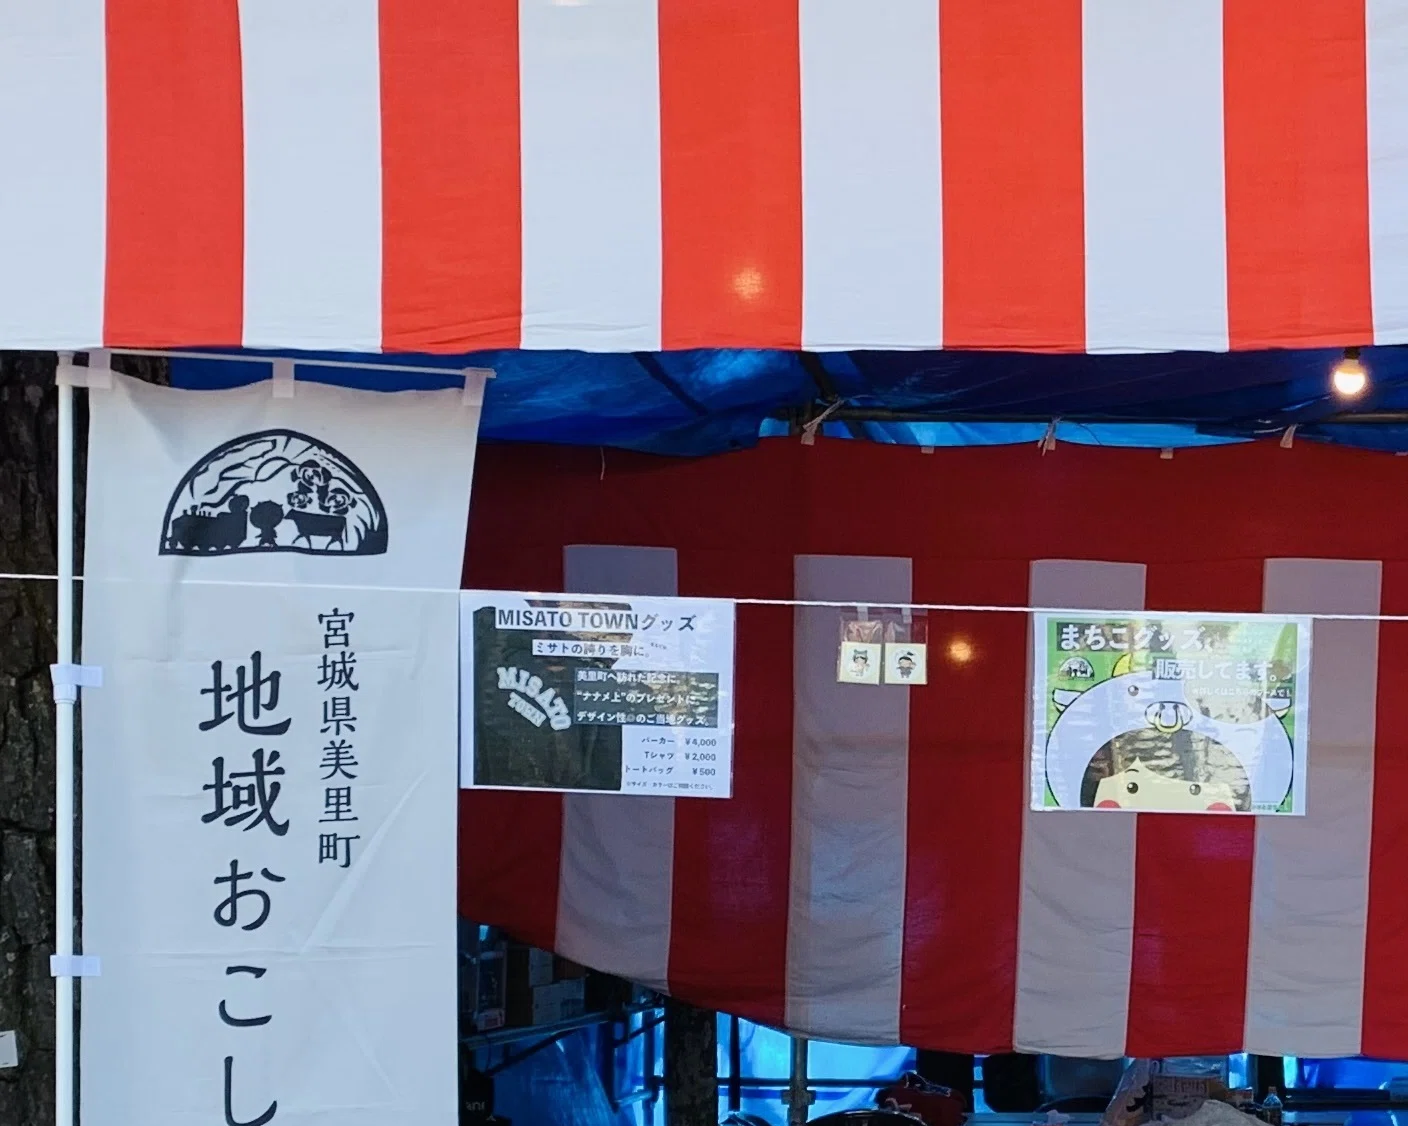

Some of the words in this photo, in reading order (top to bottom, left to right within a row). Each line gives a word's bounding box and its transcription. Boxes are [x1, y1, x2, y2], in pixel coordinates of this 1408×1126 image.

[498, 609, 572, 628] MISATO
[496, 666, 572, 731] MISATO
[317, 606, 361, 869] 宮城県美里町
